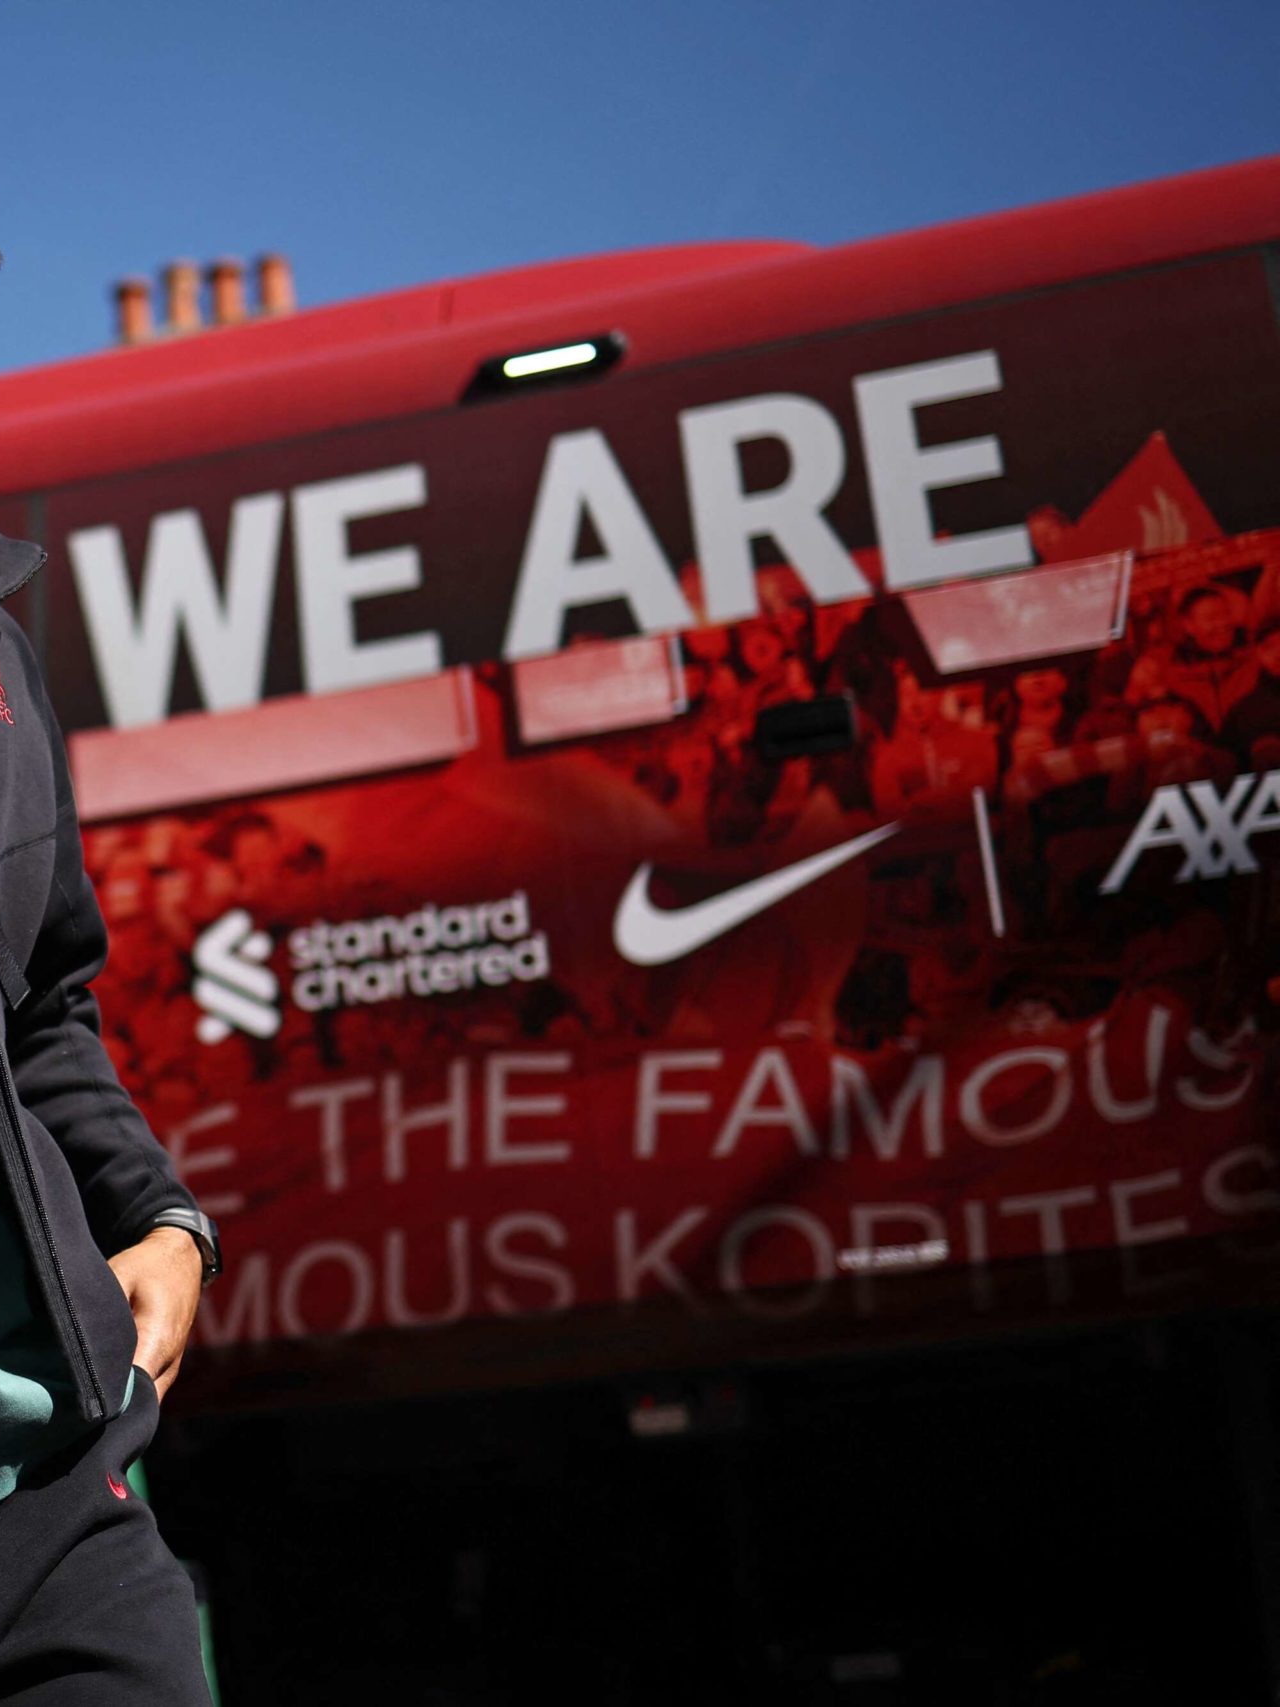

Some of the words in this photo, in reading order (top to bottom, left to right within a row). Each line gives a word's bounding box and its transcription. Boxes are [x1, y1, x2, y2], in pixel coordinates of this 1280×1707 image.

[67, 462, 444, 731] WE
[502, 349, 1036, 659] ARE
[1097, 768, 1280, 896] AXA
[287, 891, 531, 969] standard
[291, 931, 550, 1012] chartered
[291, 1052, 574, 1193] THE
[633, 1004, 1259, 1161] FAMOUS
